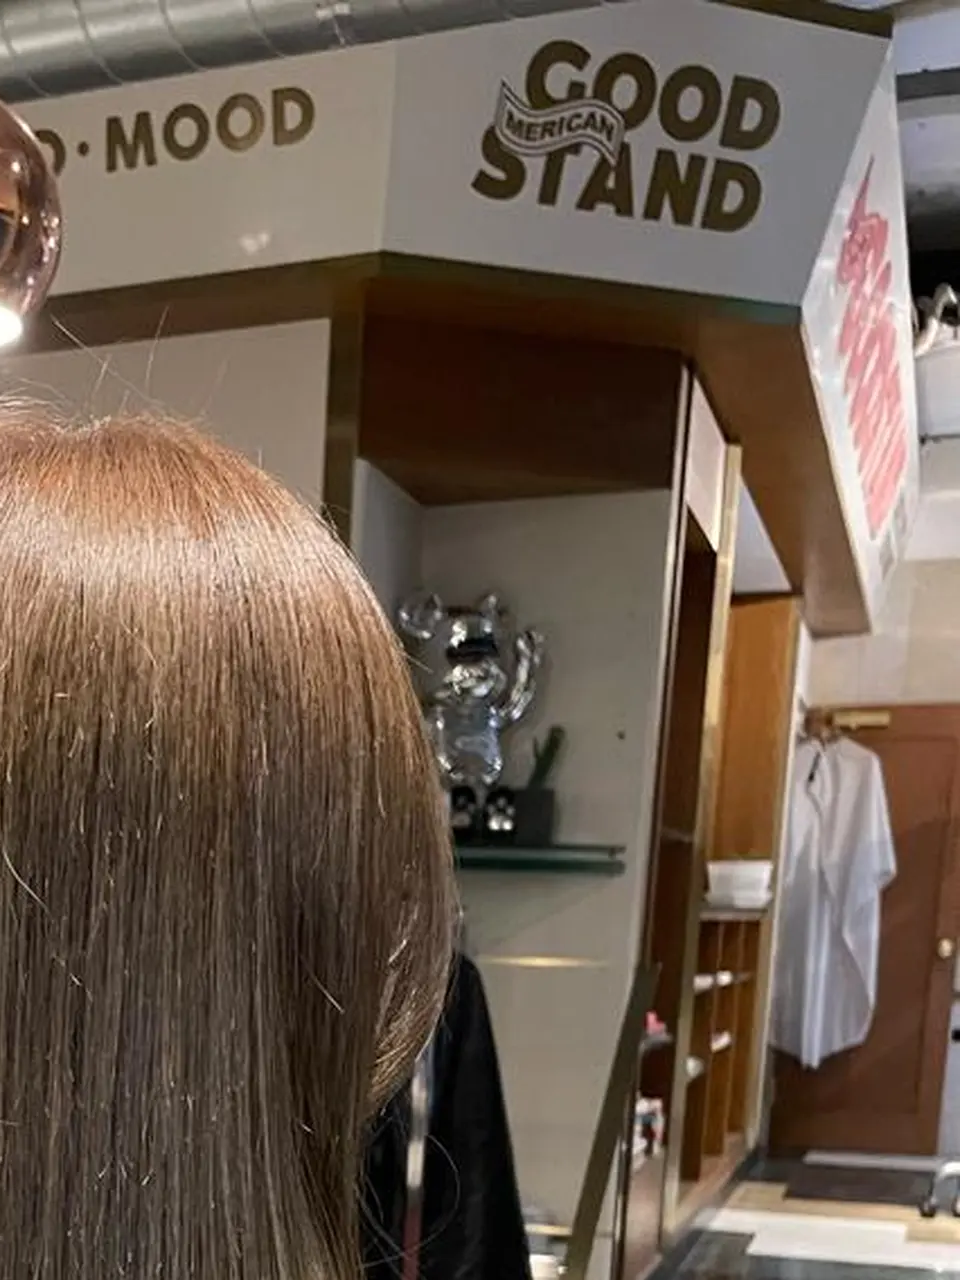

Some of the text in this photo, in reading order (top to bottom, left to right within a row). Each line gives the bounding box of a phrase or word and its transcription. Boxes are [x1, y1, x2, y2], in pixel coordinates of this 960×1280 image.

[505, 110, 616, 142] MERICAN
[525, 39, 781, 151] GOOD
[471, 124, 762, 233] STAND
